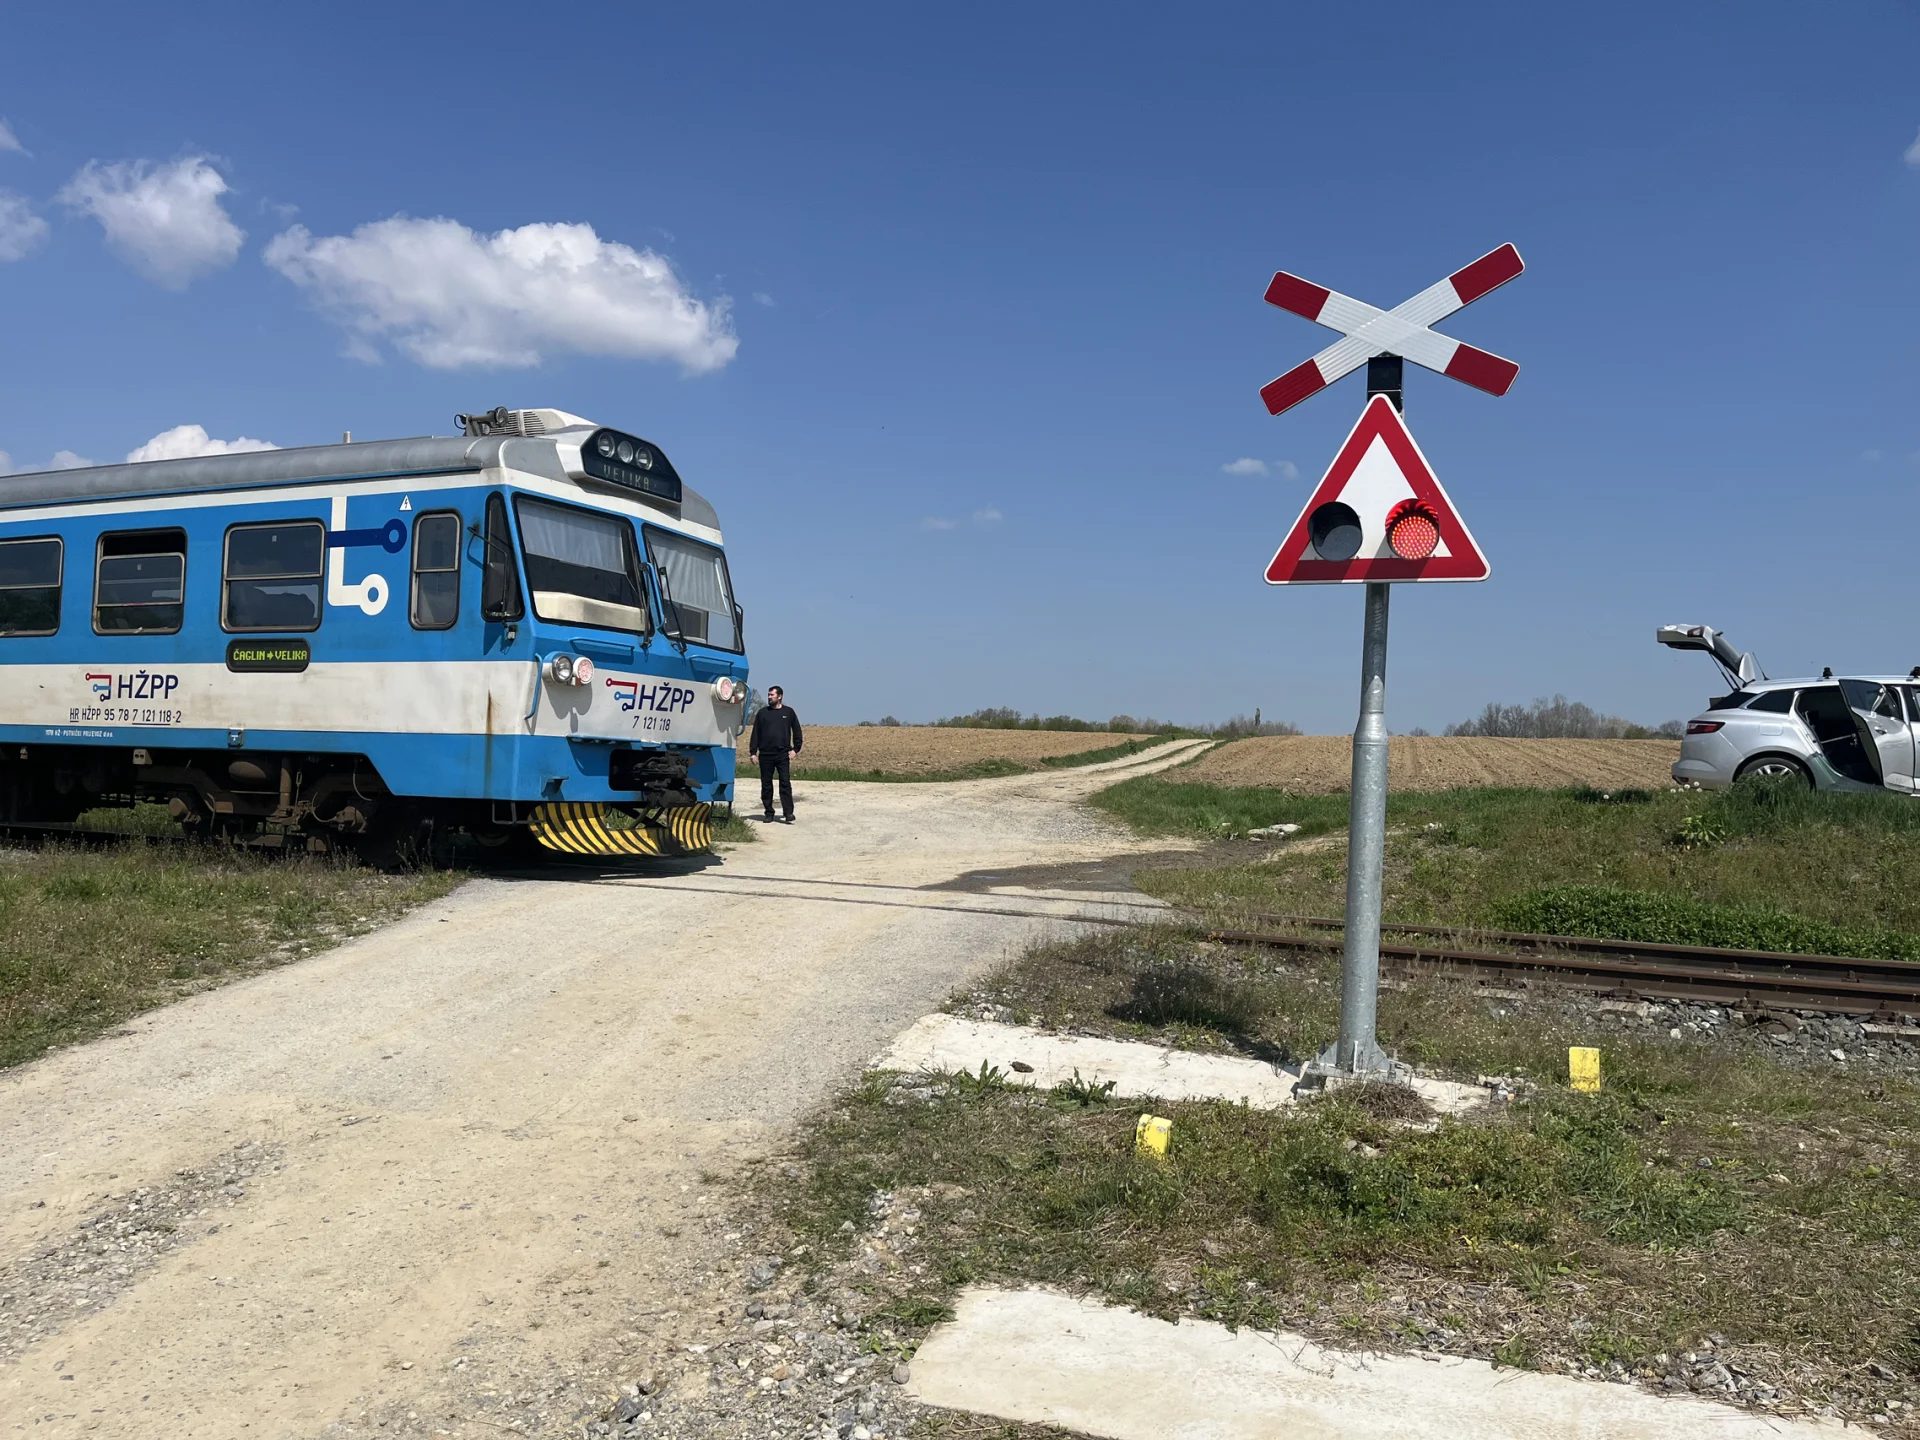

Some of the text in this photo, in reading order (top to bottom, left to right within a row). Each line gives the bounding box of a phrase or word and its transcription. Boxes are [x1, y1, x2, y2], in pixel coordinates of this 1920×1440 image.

[603, 464, 650, 491] VELIKA
[275, 650, 307, 660] VELIKA
[118, 670, 179, 699] HŽPP
[638, 682, 695, 713] HŽPP
[70, 708, 79, 720] HR
[82, 705, 101, 720] HŽPP
[104, 709, 114, 721] 95
[119, 709, 129, 721] 78
[133, 709, 138, 721] 7
[143, 709, 155, 722] 121
[632, 716, 639, 728] 7
[644, 717, 657, 730] 121
